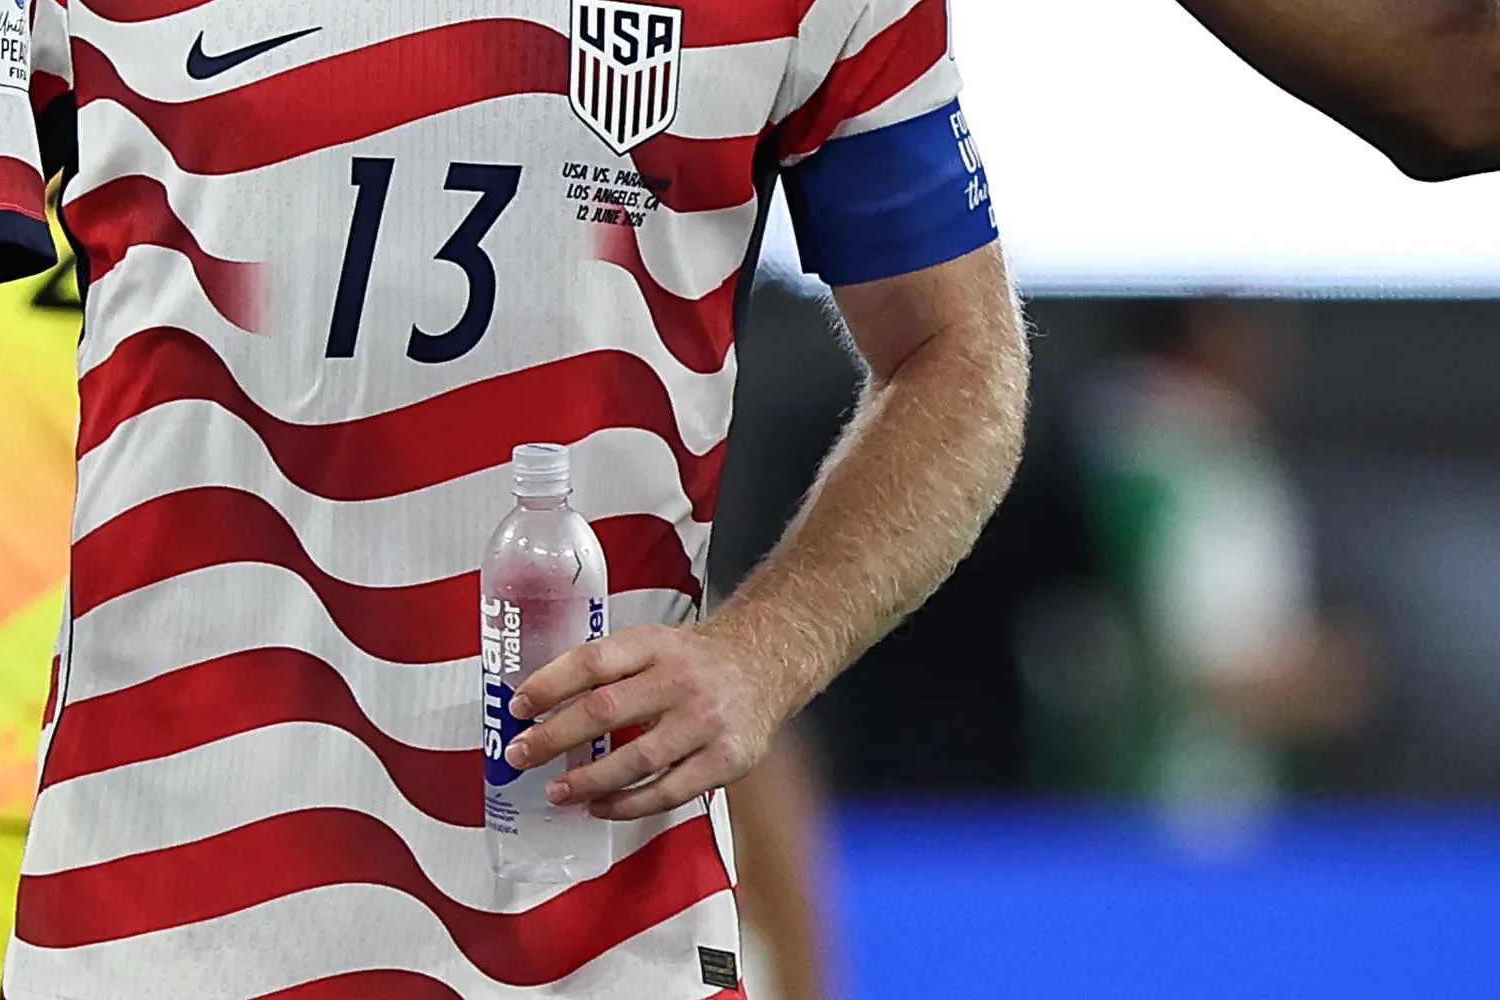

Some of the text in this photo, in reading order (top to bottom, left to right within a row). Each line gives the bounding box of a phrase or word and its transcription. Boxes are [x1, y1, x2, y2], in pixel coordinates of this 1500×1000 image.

[579, 5, 674, 66] USA
[562, 162, 588, 180] USA
[566, 183, 661, 212] LOS ANGELES, CA
[576, 204, 589, 221] 12
[591, 206, 620, 225] JUNE
[324, 156, 523, 364] 13
[502, 600, 521, 674] water
[481, 594, 502, 760] smart
